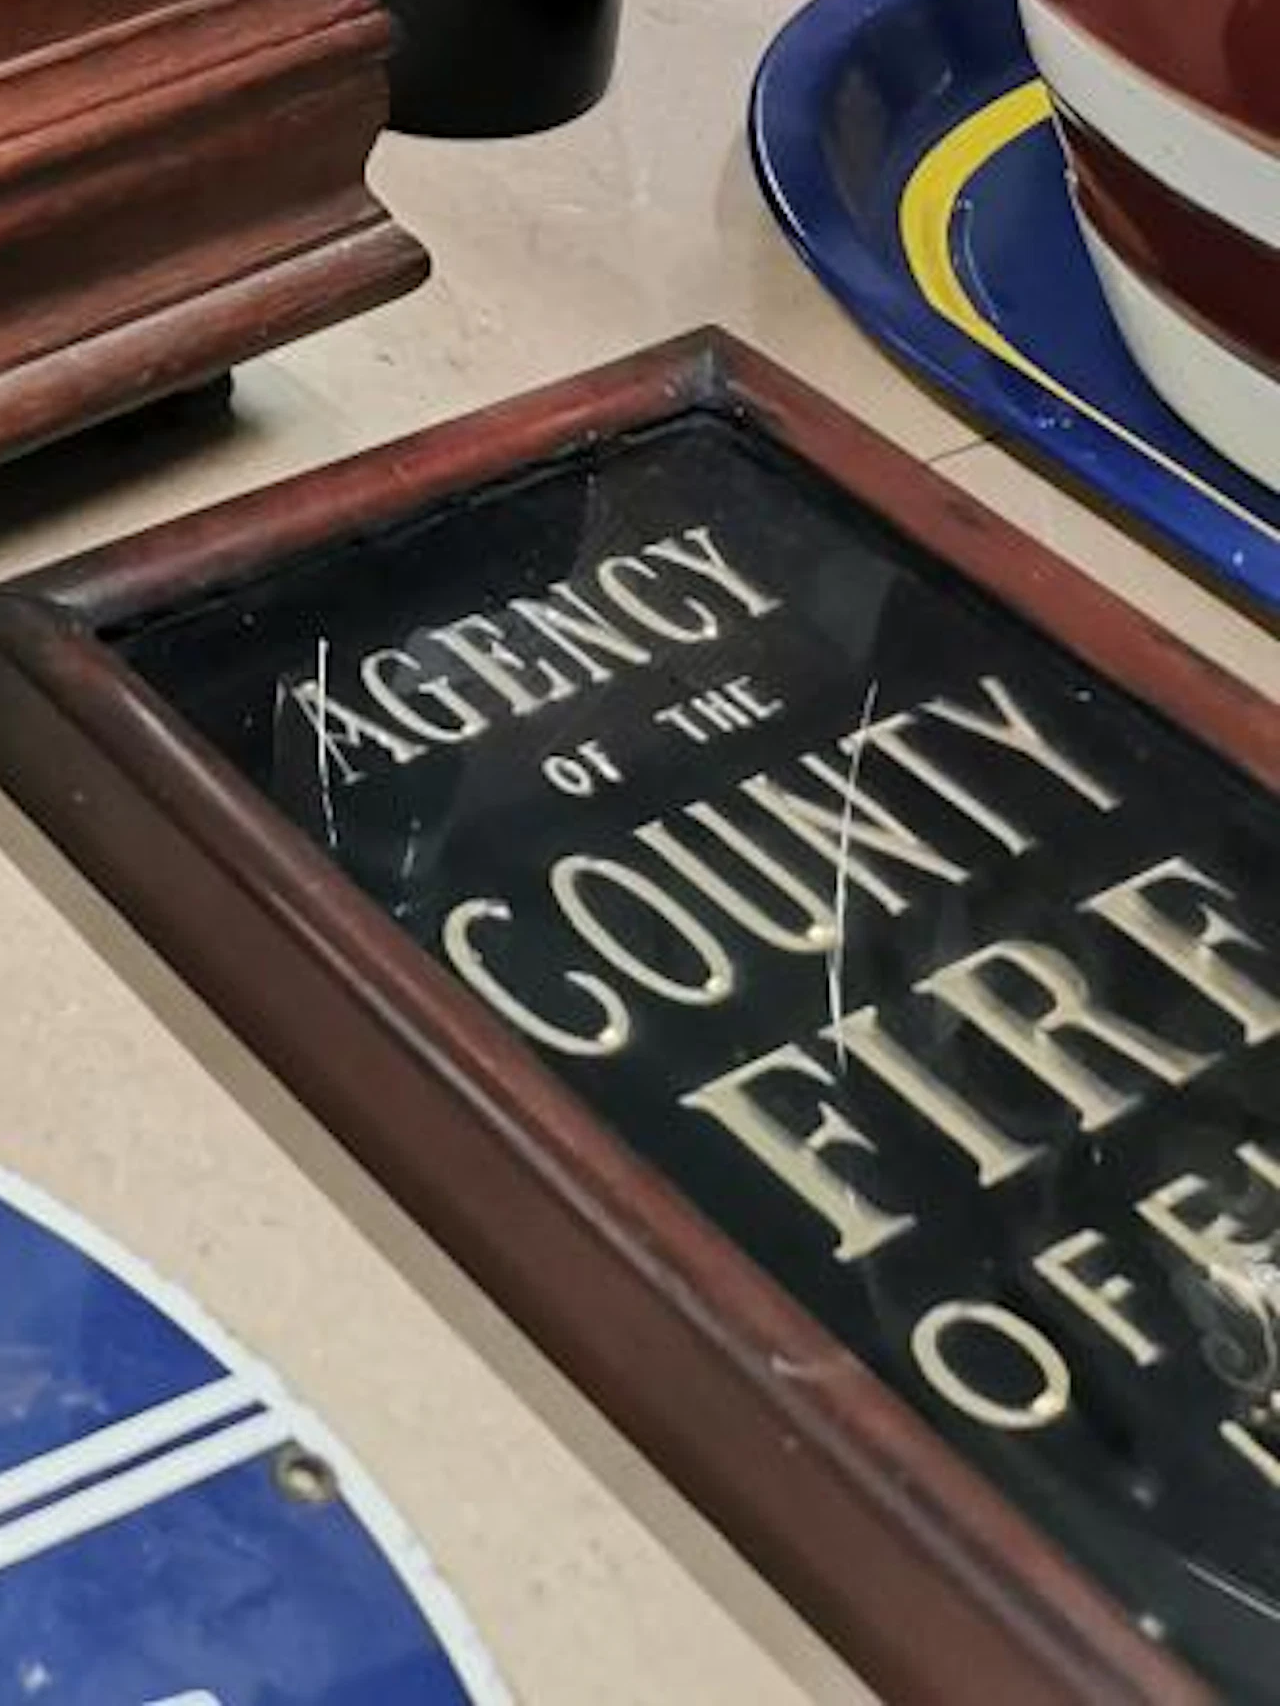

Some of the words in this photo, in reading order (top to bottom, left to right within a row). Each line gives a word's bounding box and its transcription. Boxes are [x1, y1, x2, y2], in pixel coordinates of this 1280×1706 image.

[298, 524, 784, 787] AGENCY
[540, 736, 626, 799] OF
[655, 674, 789, 747] THE
[440, 673, 1124, 1061] COUNTY
[679, 853, 1280, 1267] FIRE
